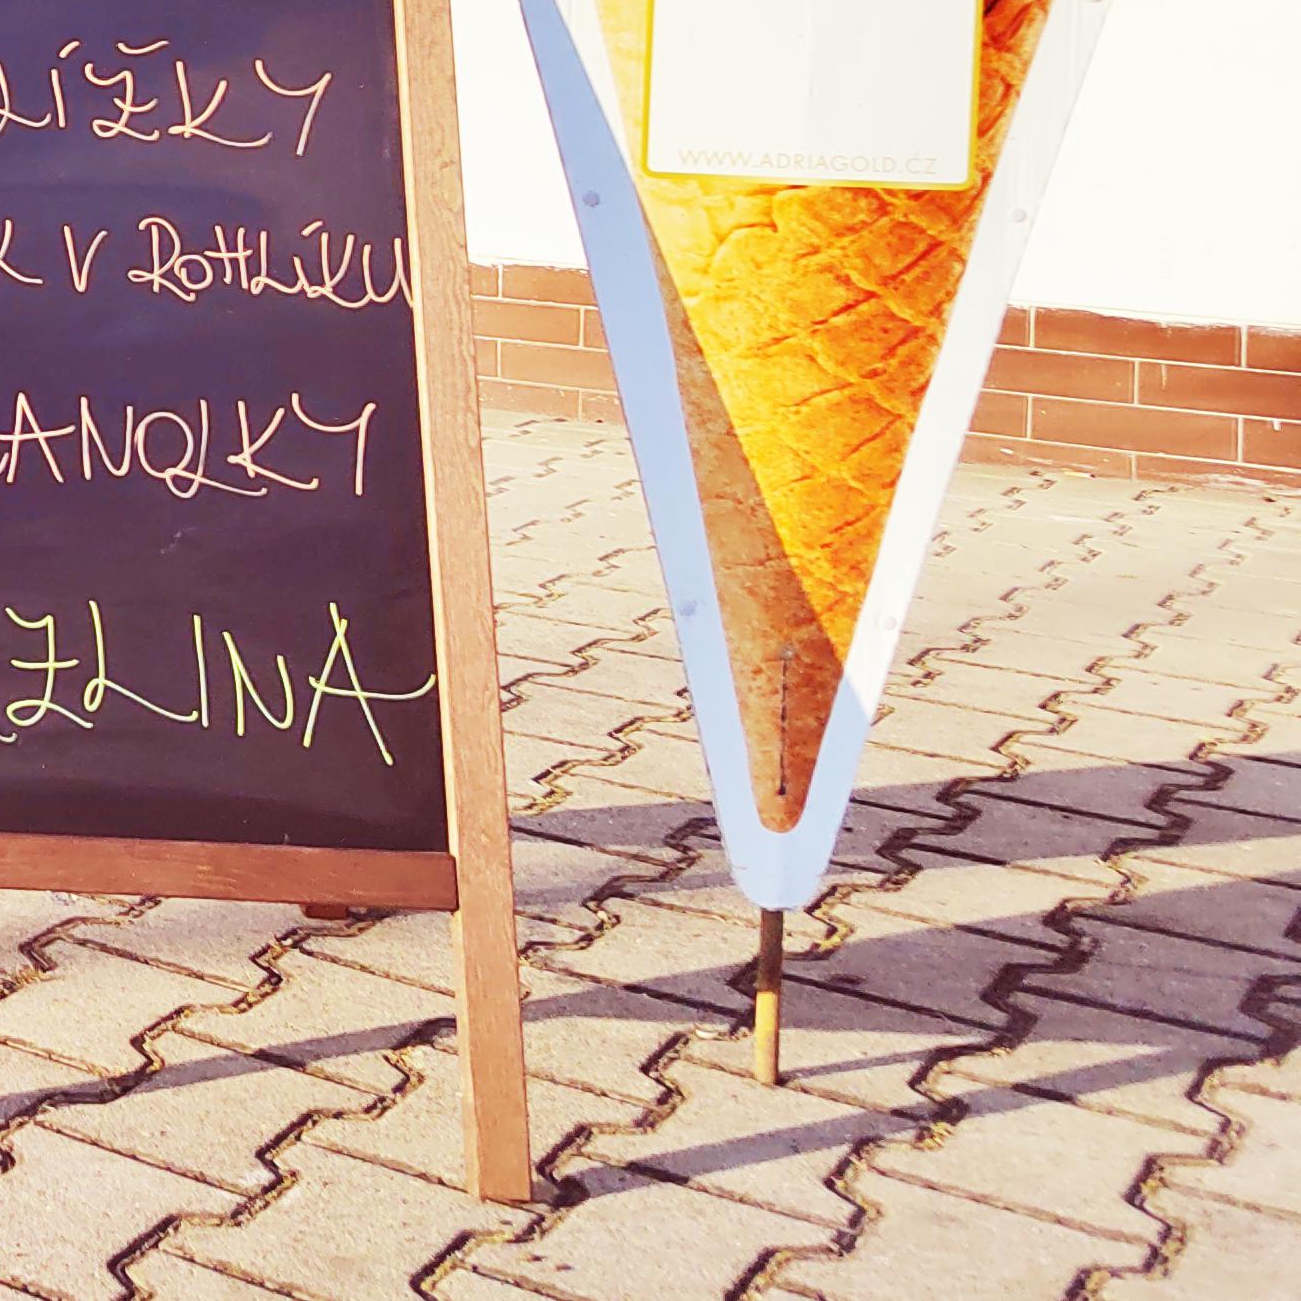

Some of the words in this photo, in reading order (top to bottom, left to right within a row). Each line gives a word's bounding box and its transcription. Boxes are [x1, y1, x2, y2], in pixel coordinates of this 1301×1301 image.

[678, 149, 940, 176] WWW.ADRIAGOLD.CZ
[62, 221, 108, 294] V
[127, 214, 417, 311] ROHLÍKU
